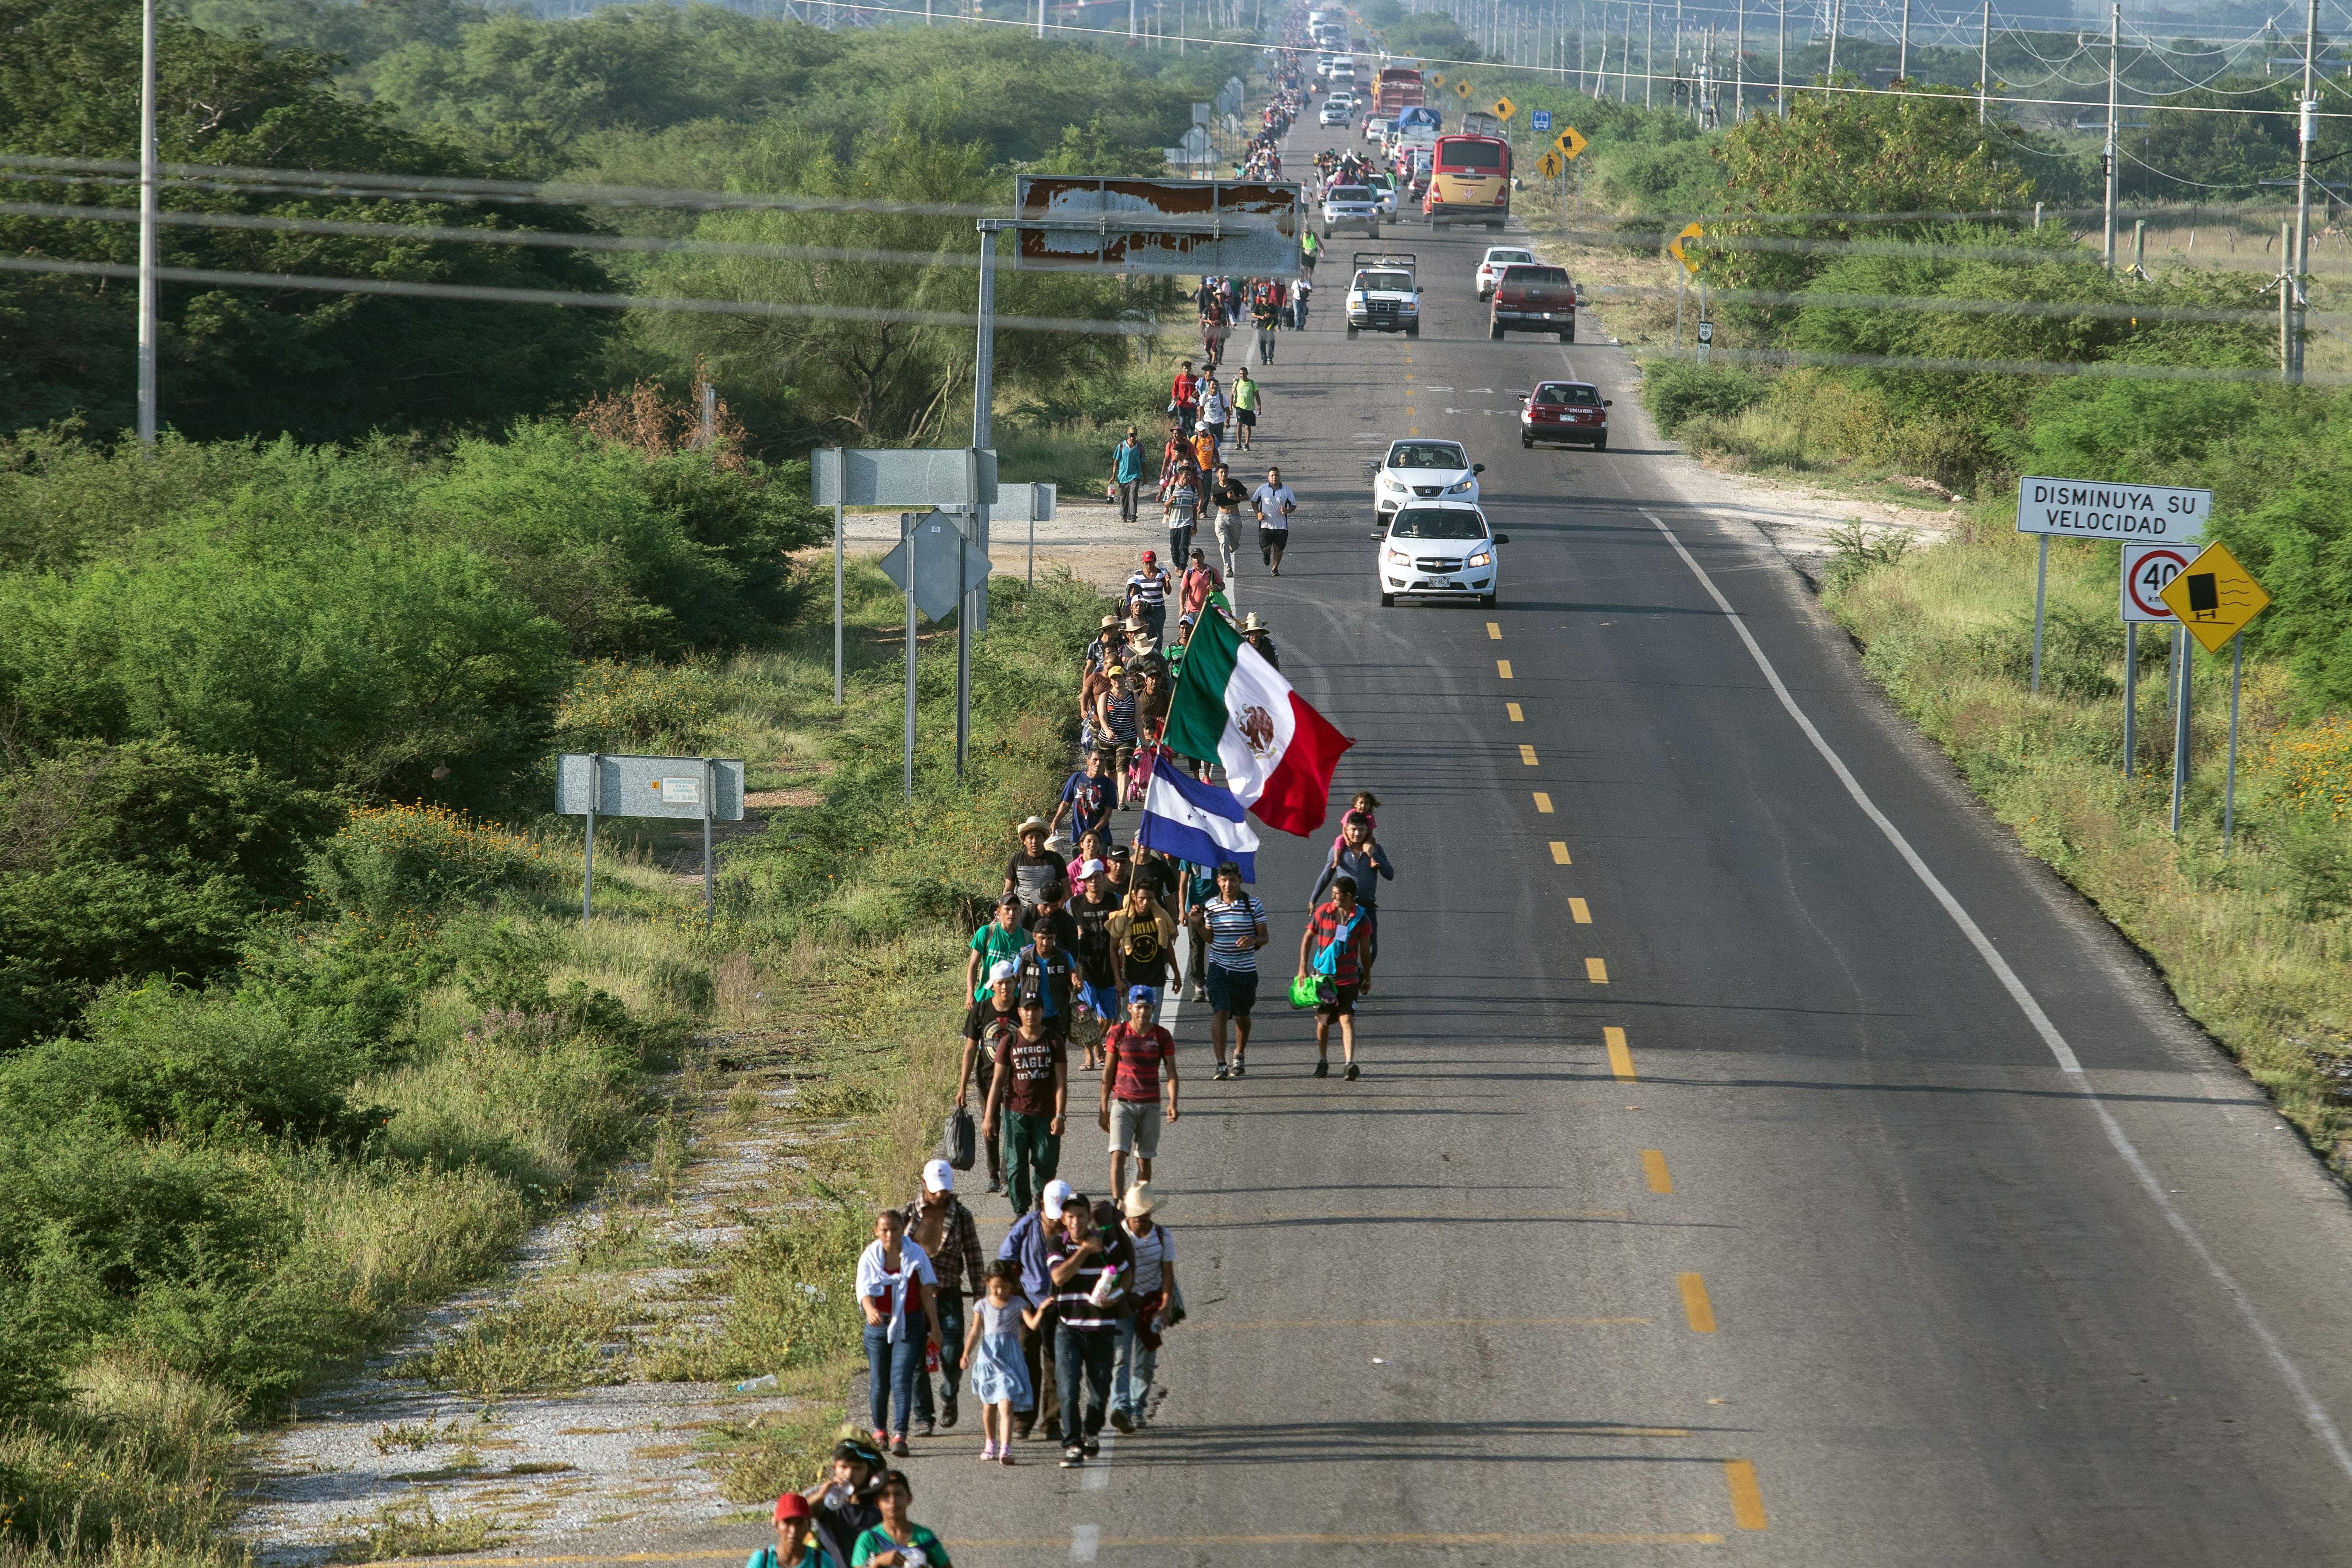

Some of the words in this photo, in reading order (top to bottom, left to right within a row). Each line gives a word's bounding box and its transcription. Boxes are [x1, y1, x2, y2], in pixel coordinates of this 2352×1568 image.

[2035, 486, 2154, 511] DISMINUYA
[2168, 496, 2196, 514] SU
[2046, 509, 2166, 534] VELOCIDAD
[2143, 563, 2179, 590] 40
[1012, 1046, 1050, 1056] AMERICAN
[1013, 1056, 1052, 1069] EAGLE
